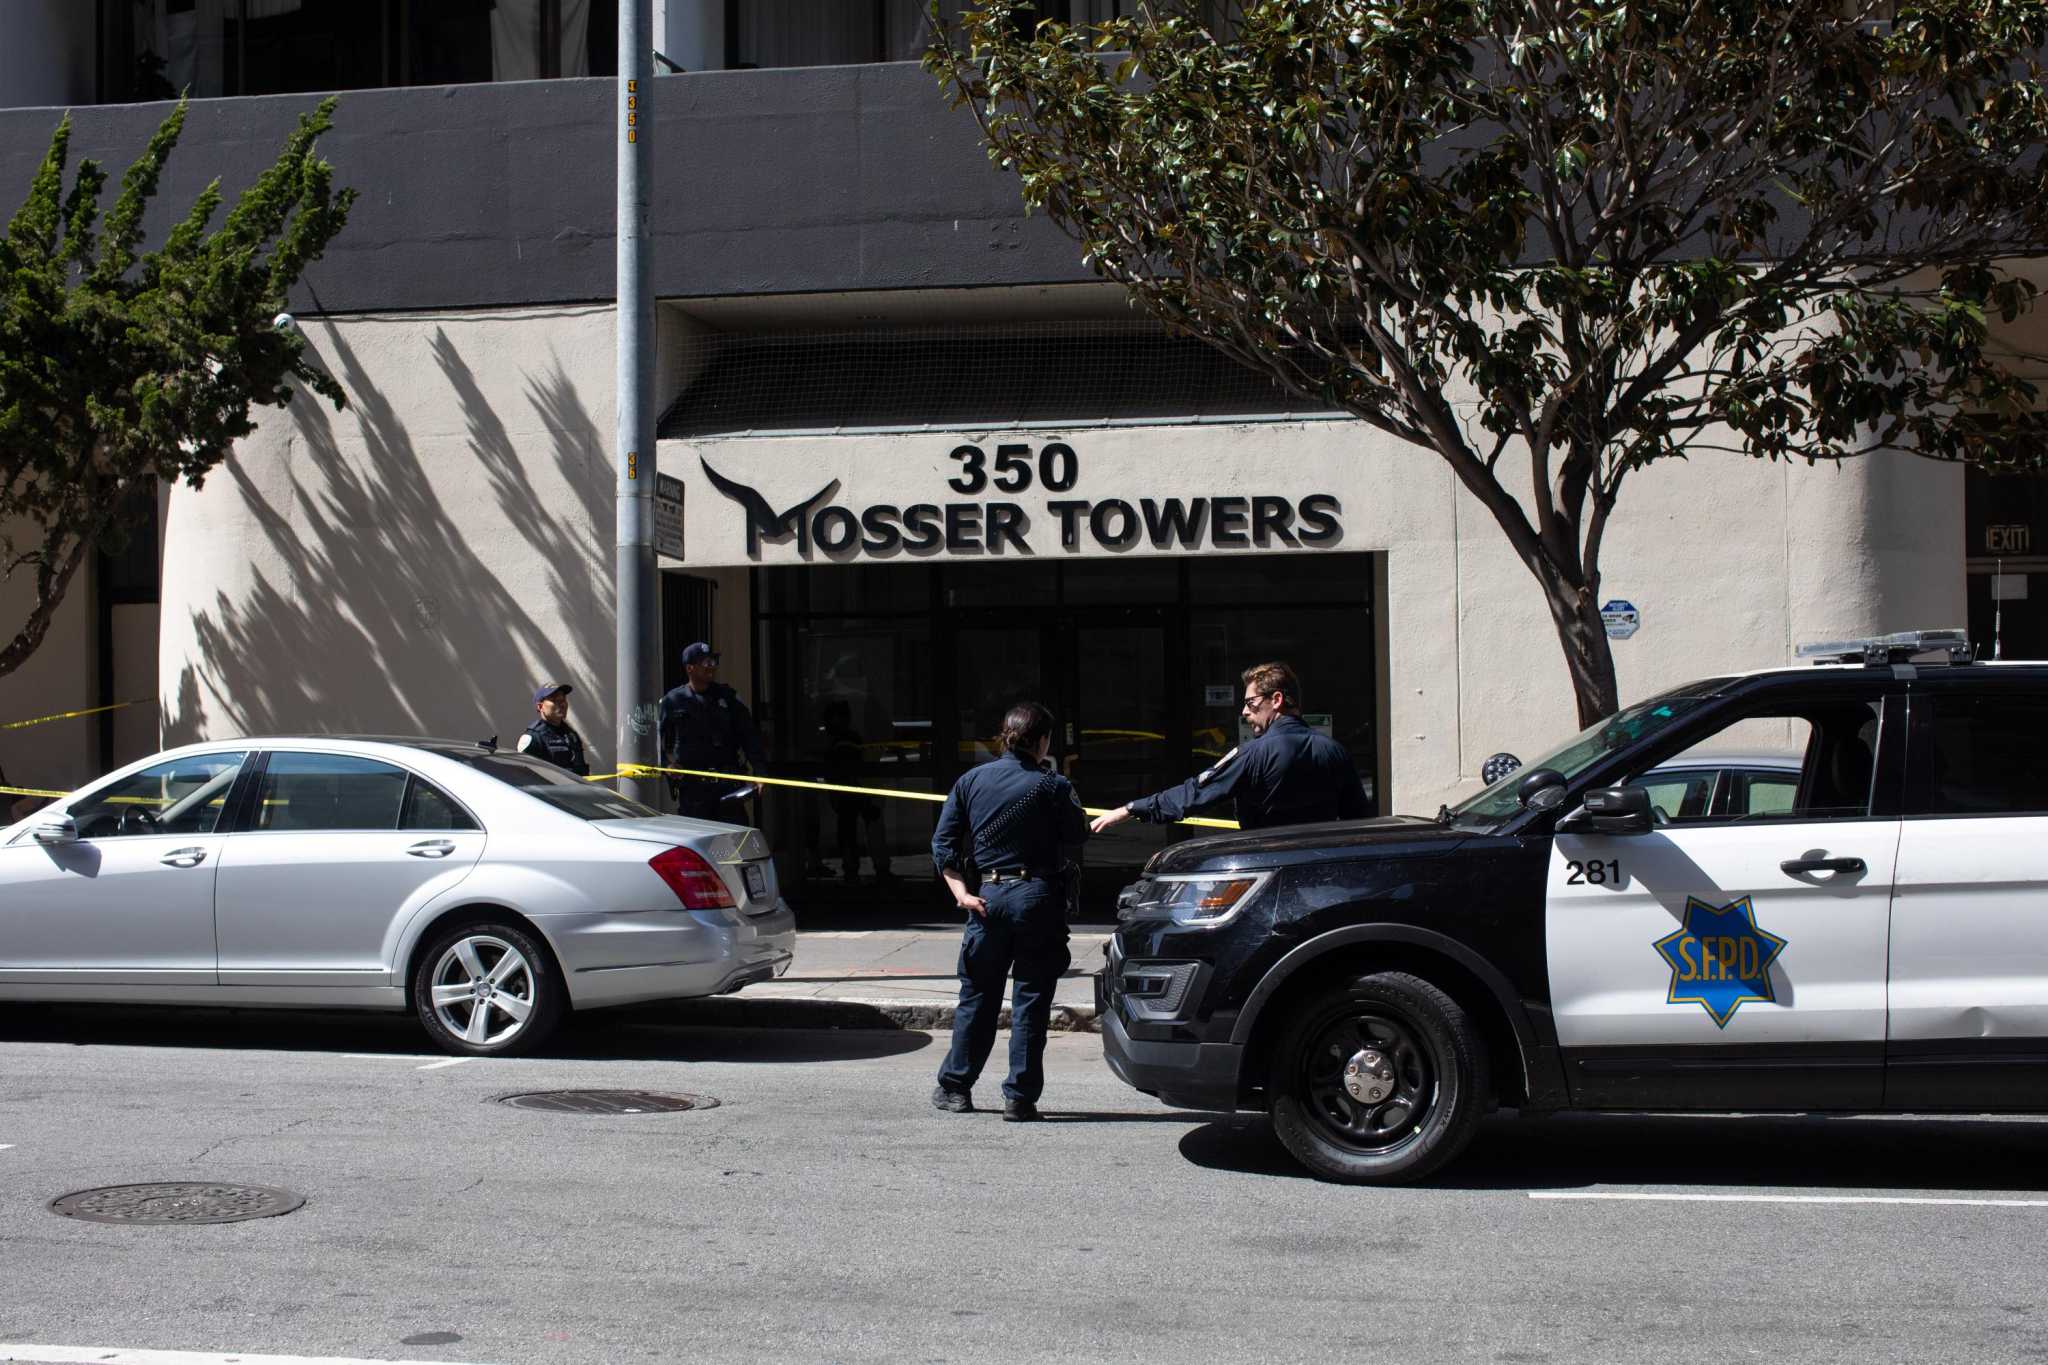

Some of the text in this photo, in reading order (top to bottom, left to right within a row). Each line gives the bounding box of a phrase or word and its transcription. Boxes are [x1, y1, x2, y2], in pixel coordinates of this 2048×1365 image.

[948, 443, 1079, 494] 350
[700, 456, 1034, 558] MOSSER
[1047, 495, 1341, 550] TOWERS
[1990, 527, 2025, 550] EXIT
[1566, 859, 1620, 885] 281
